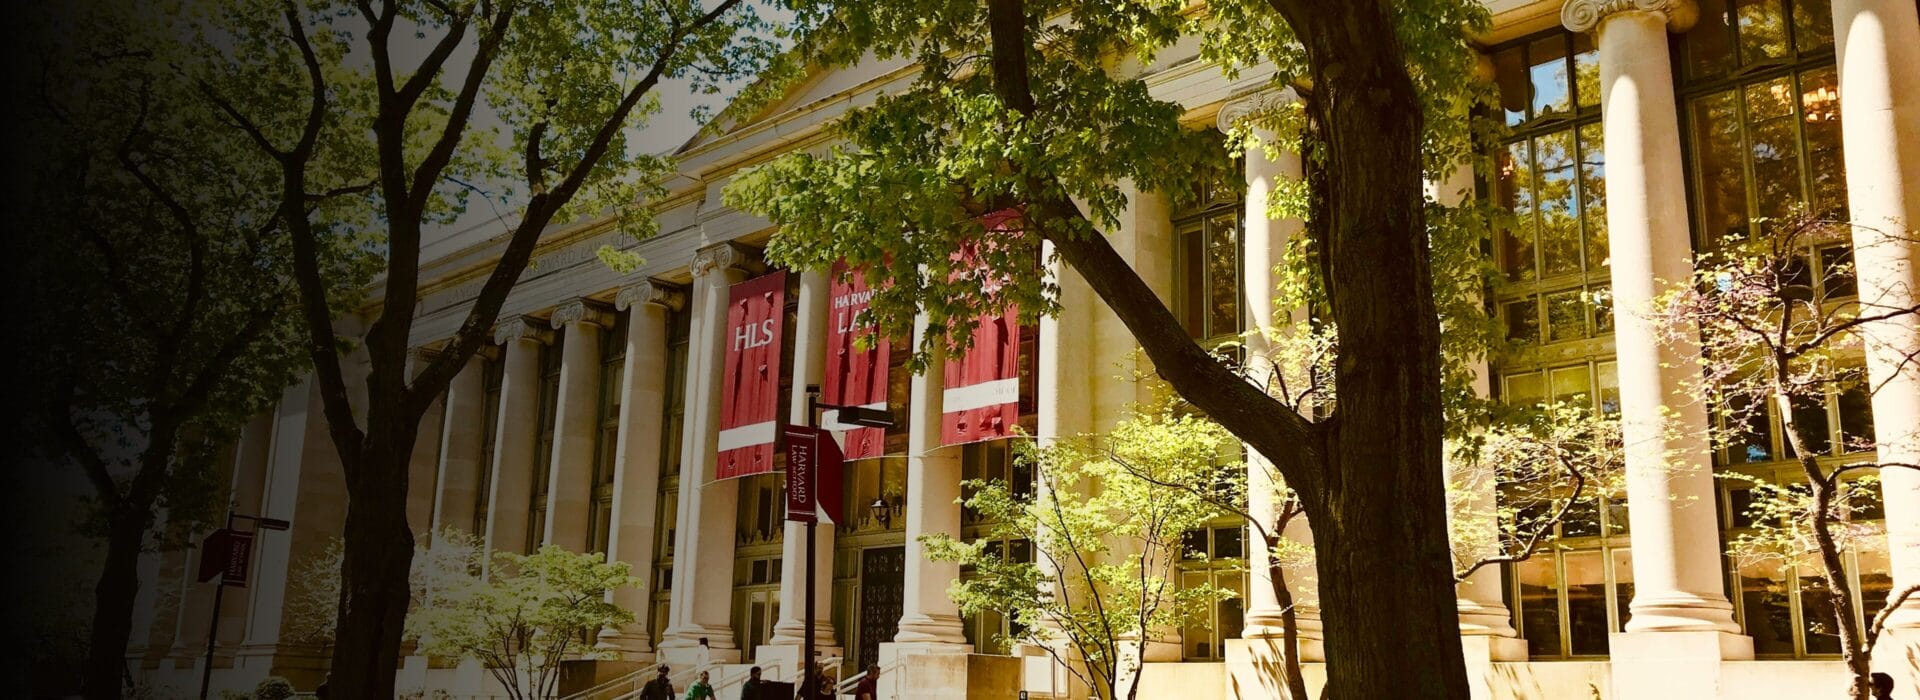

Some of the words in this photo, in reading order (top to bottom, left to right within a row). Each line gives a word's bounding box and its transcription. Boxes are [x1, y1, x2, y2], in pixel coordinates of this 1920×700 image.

[834, 289, 878, 309] HARVA
[734, 319, 774, 352] HLS
[838, 308, 877, 334] LA
[797, 445, 808, 504] HARVARD
